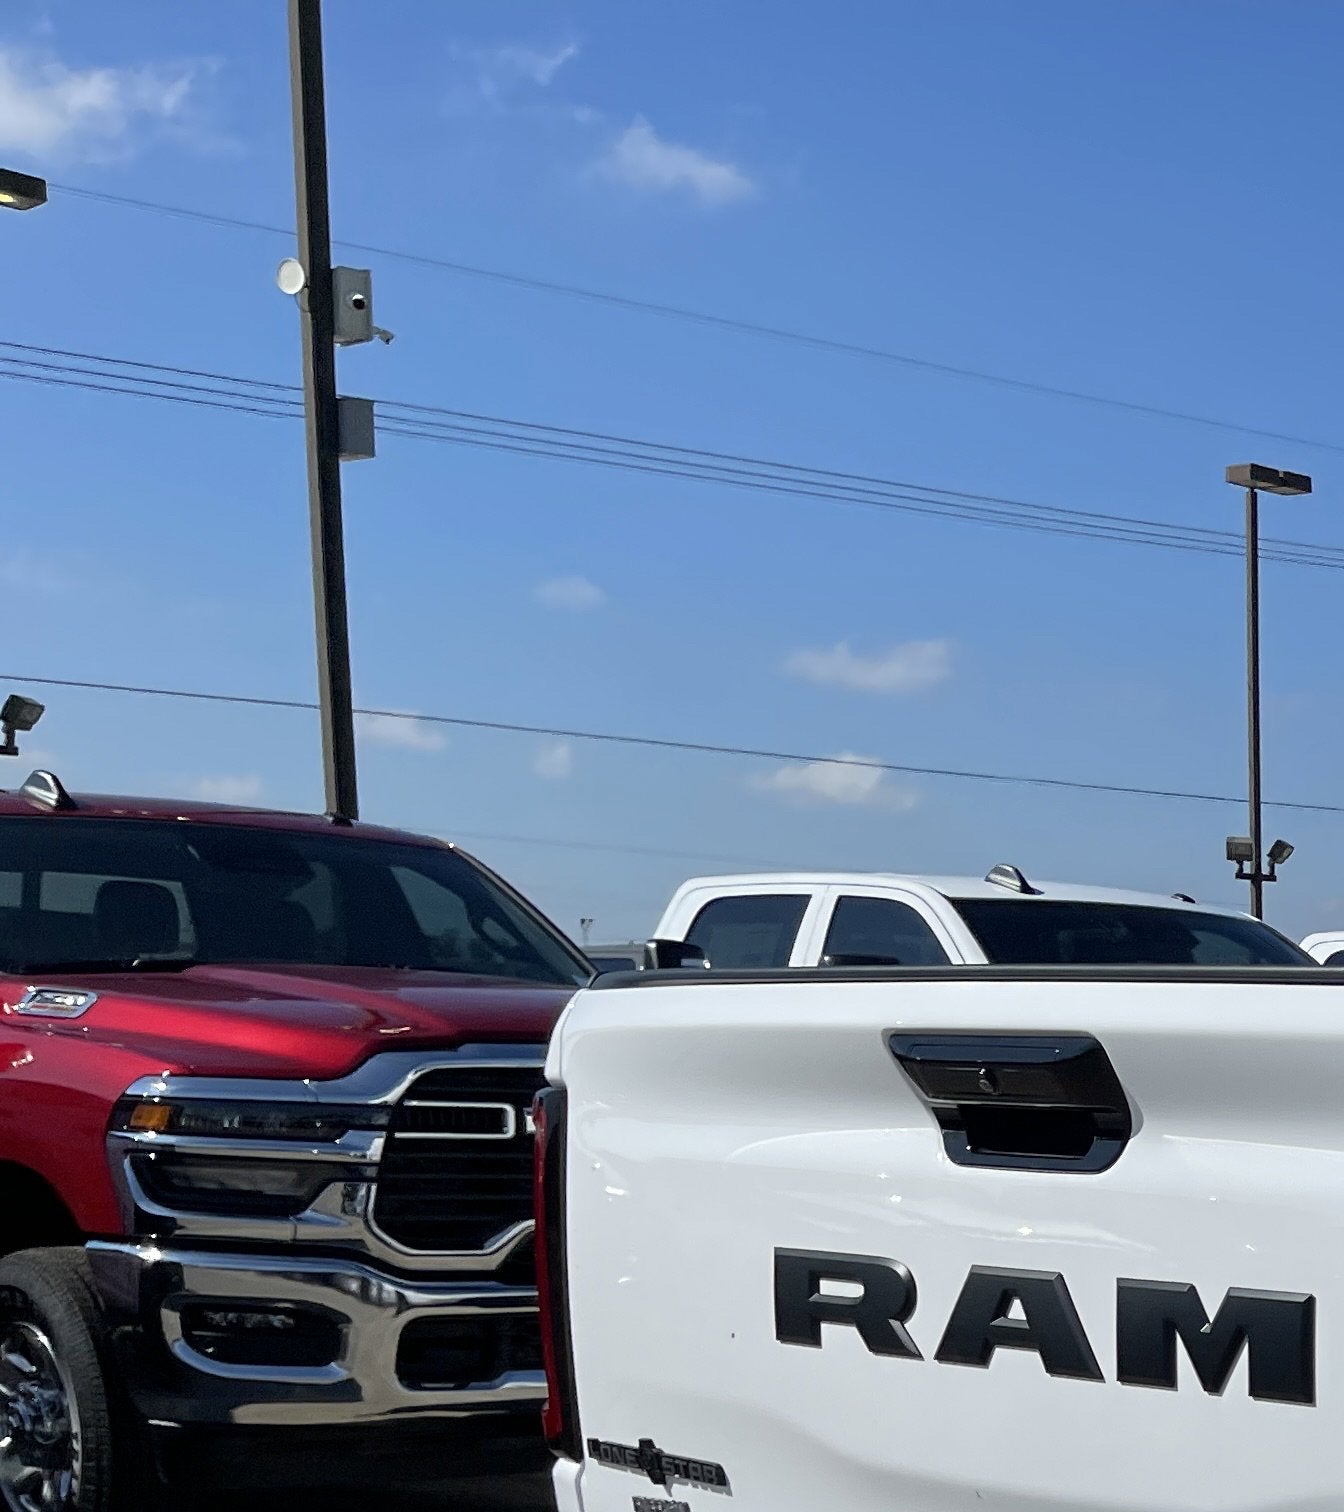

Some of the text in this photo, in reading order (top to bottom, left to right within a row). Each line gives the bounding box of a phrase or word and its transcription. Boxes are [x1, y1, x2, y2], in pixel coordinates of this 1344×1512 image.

[774, 1247, 1317, 1407] RAM
[588, 1439, 721, 1485] LONE STAR
